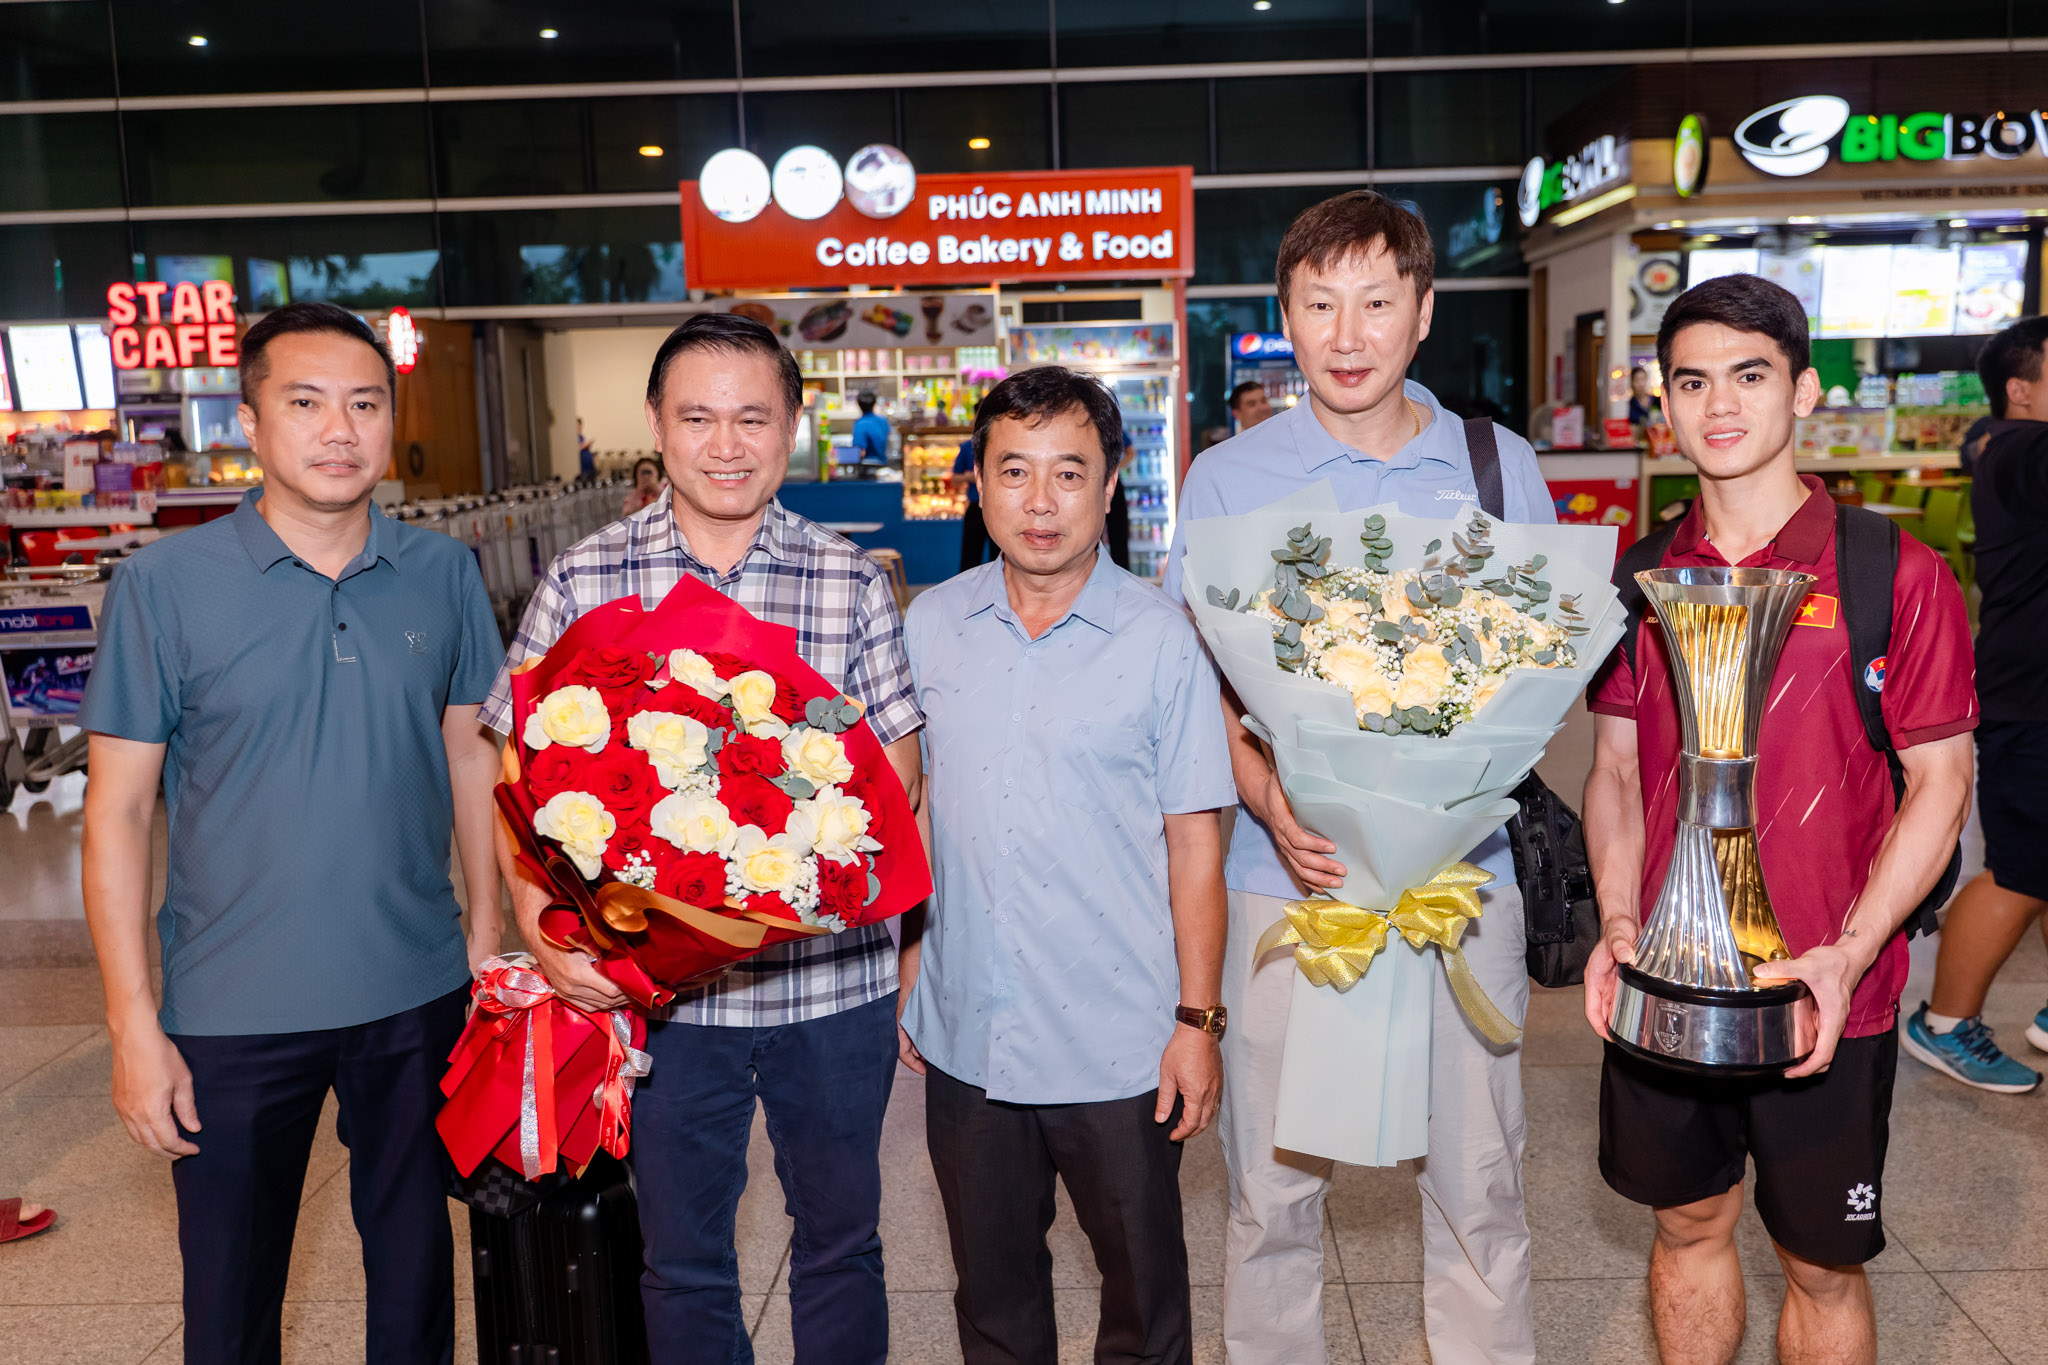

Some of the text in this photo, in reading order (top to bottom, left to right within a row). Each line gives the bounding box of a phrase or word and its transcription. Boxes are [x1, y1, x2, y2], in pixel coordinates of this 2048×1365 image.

[1841, 110, 2048, 163] BIGBO
[929, 186, 1162, 220] PHÚC ANH MINH
[816, 230, 1173, 267] Coffee Bakery & Food
[107, 280, 236, 325] STAR
[111, 323, 239, 370] CAFE
